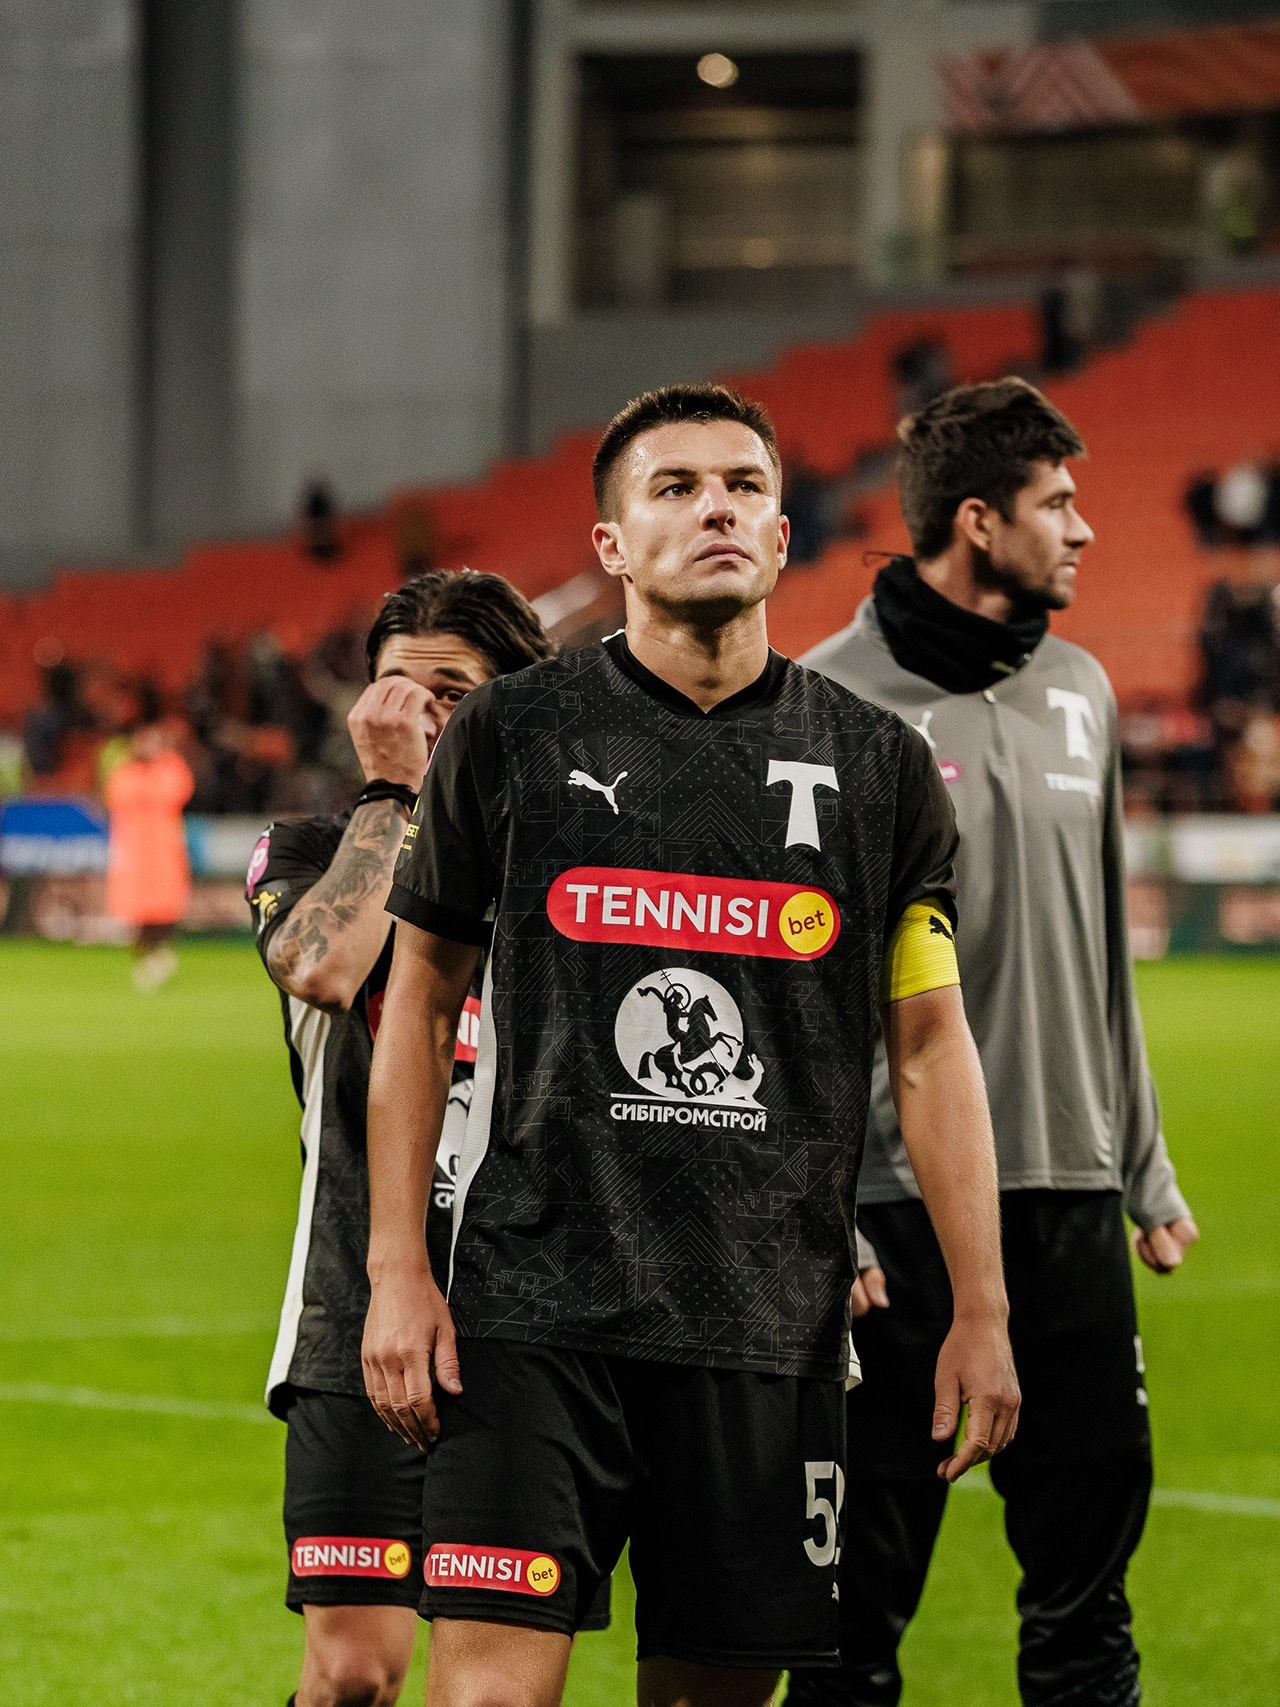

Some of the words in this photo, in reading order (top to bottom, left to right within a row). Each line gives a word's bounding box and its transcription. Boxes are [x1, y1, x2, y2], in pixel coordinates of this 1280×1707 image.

[766, 758, 840, 852] T
[565, 883, 769, 939] TENNISI
[788, 909, 826, 936] bet
[609, 1101, 768, 1132] СИБПРОМСТРОЙ
[295, 1545, 381, 1569] TENNISI
[389, 1552, 407, 1565] bet
[430, 1553, 522, 1582] TENNISI
[531, 1567, 554, 1582] bet
